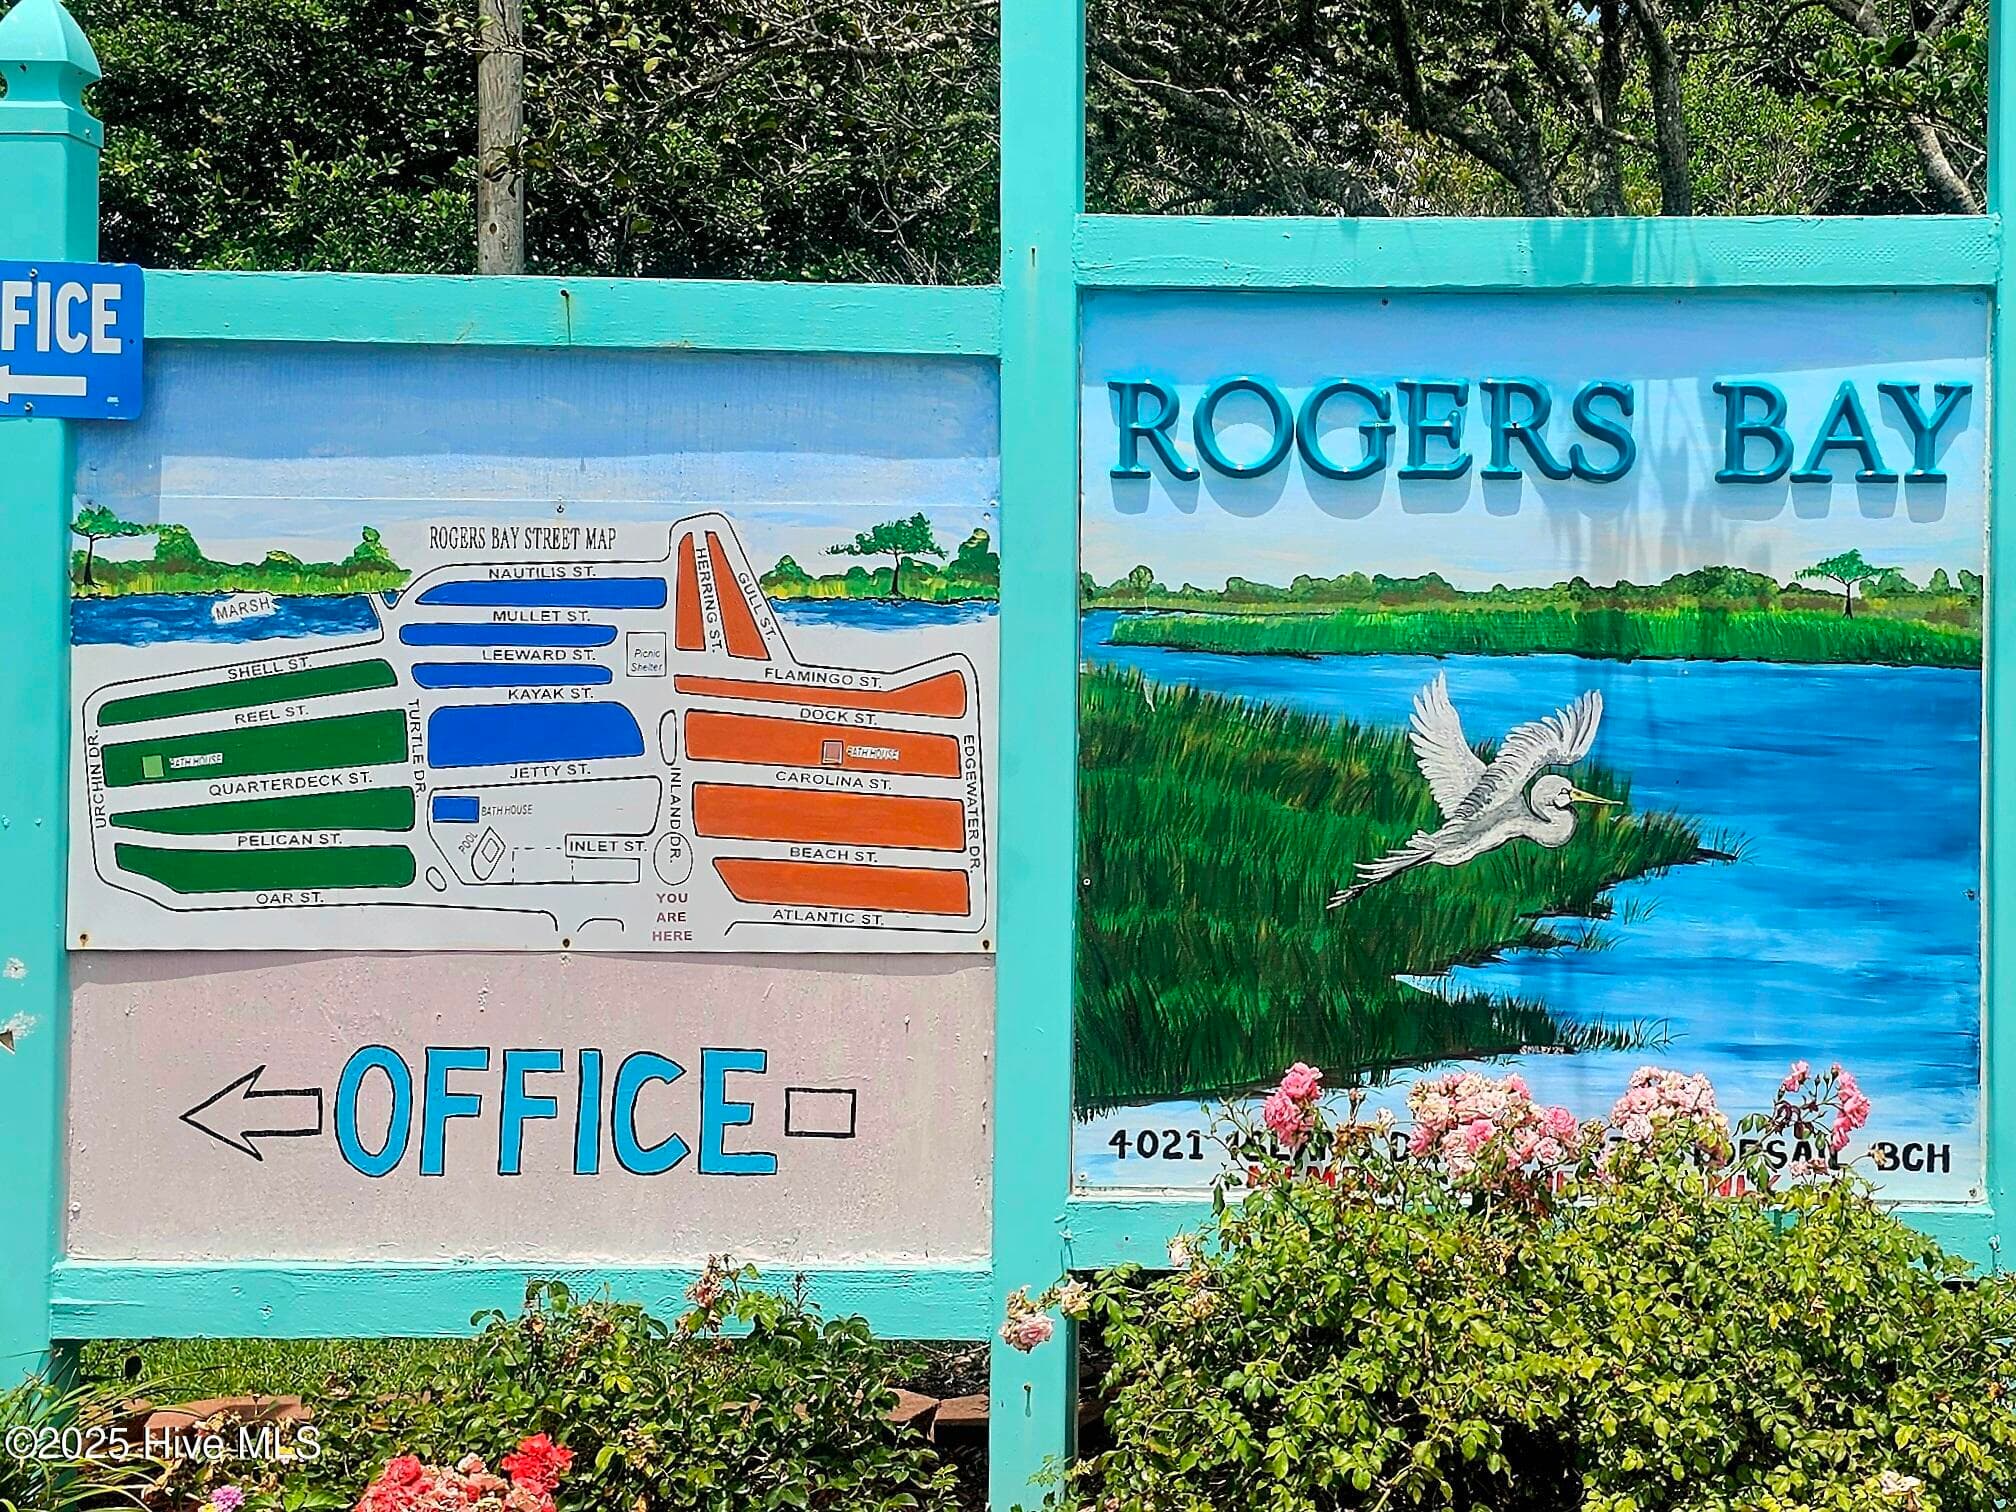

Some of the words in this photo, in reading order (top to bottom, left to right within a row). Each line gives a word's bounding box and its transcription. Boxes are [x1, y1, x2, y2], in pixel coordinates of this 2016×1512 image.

[1, 280, 122, 354] FICE
[1107, 374, 1636, 484] ROGERS
[1712, 378, 1973, 485] BAY
[429, 526, 486, 550] ROGERS
[491, 526, 520, 550] BAY
[524, 526, 581, 550] STREET
[585, 526, 616, 550] MAP
[489, 566, 566, 579] NAUTILIS
[572, 565, 596, 577] ST.
[215, 597, 271, 620] MARSH
[695, 547, 719, 624] HERRING
[708, 627, 724, 654] ST.
[738, 571, 763, 615] GULL
[760, 617, 777, 641] ST.
[493, 610, 561, 622] MULLET
[567, 610, 591, 622] ST.
[482, 649, 567, 661] LEEWARD
[572, 649, 596, 661] ST.
[633, 648, 661, 658] Picnic
[227, 660, 284, 681] SHELL
[287, 657, 313, 674] ST.
[630, 661, 663, 672] Shelter
[764, 667, 854, 686] FLAMINGO
[859, 676, 882, 689] ST.
[508, 688, 565, 700] KAYAK
[570, 687, 594, 700] ST.
[234, 709, 281, 724] REEL
[284, 705, 309, 717] ST.
[800, 708, 849, 723] DOCK
[854, 712, 878, 726] ST.
[407, 698, 425, 766] TURTLE
[87, 729, 100, 761] DR.
[510, 765, 562, 779] JETTY
[567, 764, 591, 776] ST.
[775, 771, 864, 789] CAROLINA
[868, 776, 892, 790] ST.
[209, 772, 343, 796] QUARTERDECK
[348, 771, 374, 787] ST.
[412, 770, 427, 798] DR.
[963, 734, 981, 842] EDGEWATER
[88, 766, 107, 829] URCHIN
[669, 767, 682, 831] INLAND
[481, 806, 503, 816] BATH
[504, 804, 533, 815] HOUSE
[237, 832, 315, 848] PELICAN
[319, 832, 342, 845] ST.
[458, 831, 479, 856] POOL
[569, 840, 619, 852] INLET
[623, 840, 648, 852] ST.
[669, 834, 682, 863] DR.
[790, 847, 849, 861] BEACH
[855, 850, 878, 863] ST.
[969, 846, 982, 874] DR.
[255, 892, 296, 905] OAR
[300, 891, 324, 904] ST.
[656, 892, 689, 904] YOU
[656, 911, 687, 923] ARE
[772, 908, 856, 924] ATLANTIC
[860, 913, 884, 926] ST.
[651, 930, 693, 942] HERE
[333, 1044, 778, 1178] OFFICE
[1107, 1129, 1205, 1161] 4021
[1876, 1141, 1951, 1173] BCH
